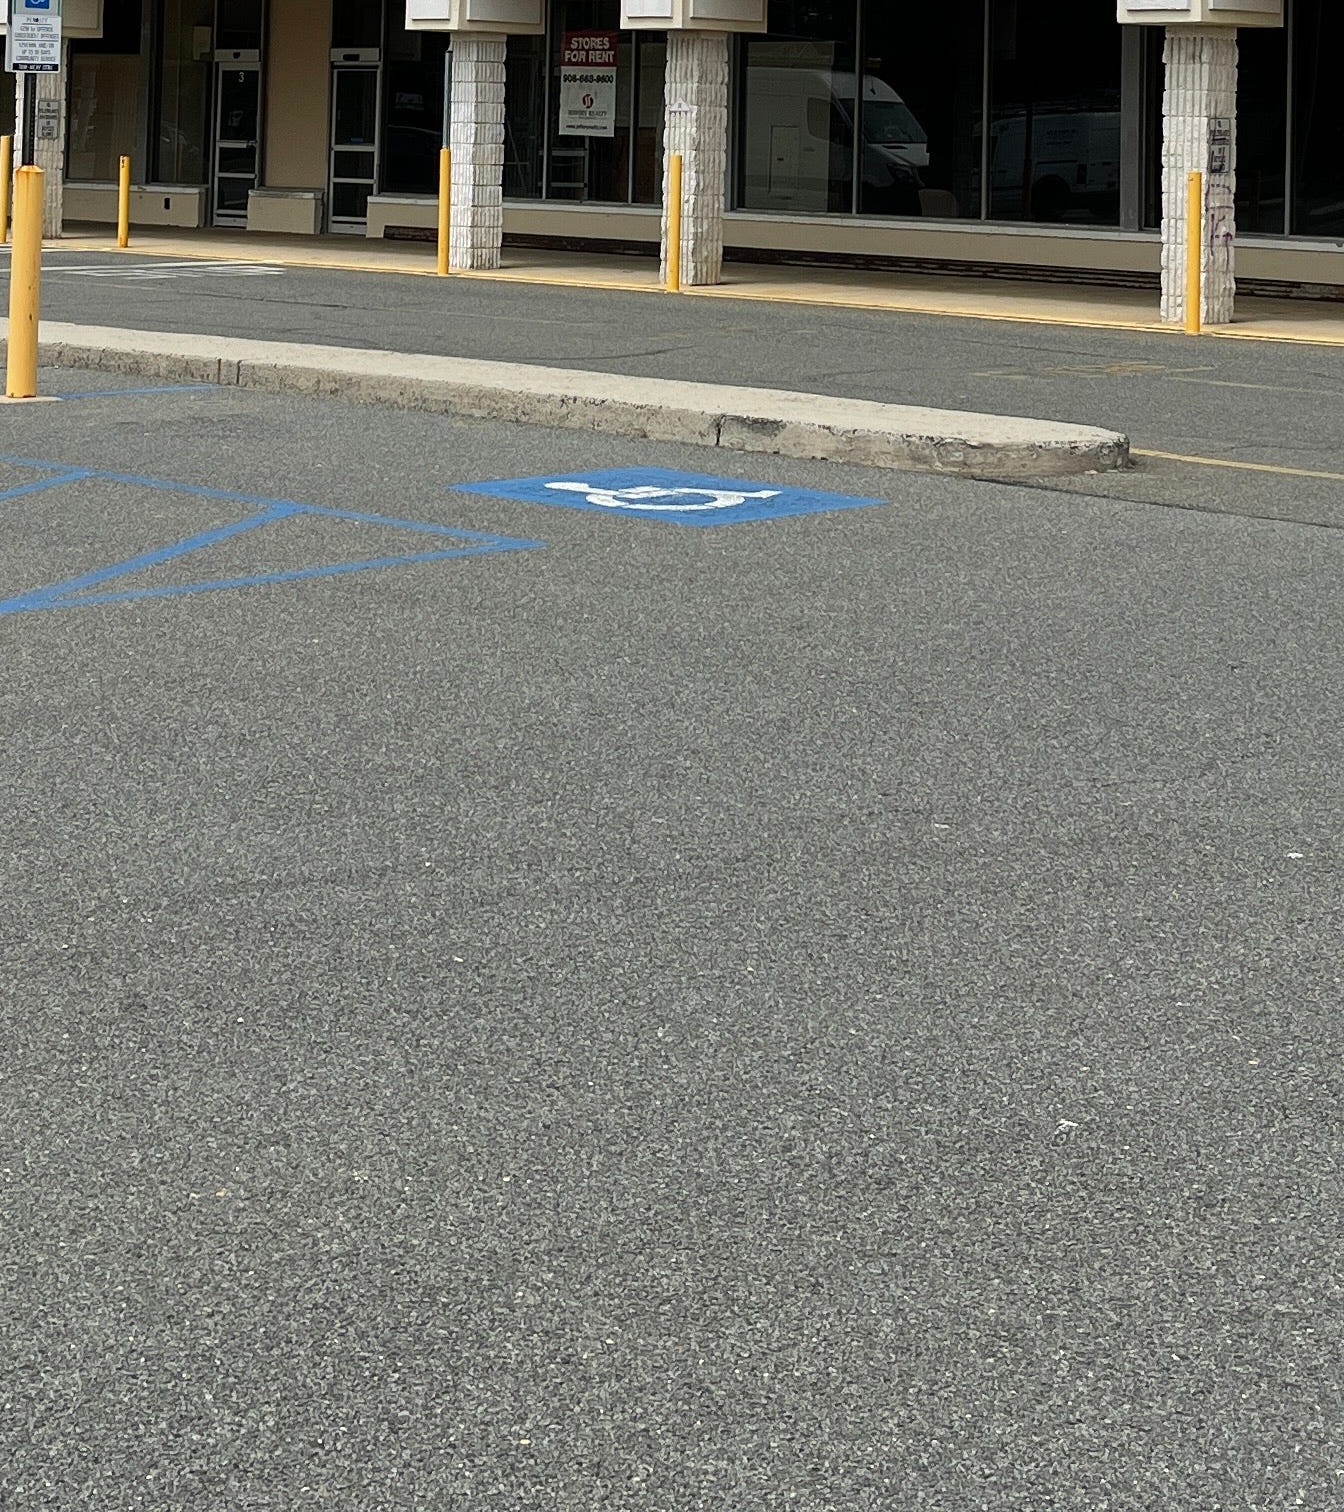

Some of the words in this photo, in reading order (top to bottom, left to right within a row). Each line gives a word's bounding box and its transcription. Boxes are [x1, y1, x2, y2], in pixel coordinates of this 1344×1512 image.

[570, 37, 610, 50] STORES
[564, 50, 586, 63] FOR
[588, 50, 615, 63] RENT
[238, 71, 245, 83] 3
